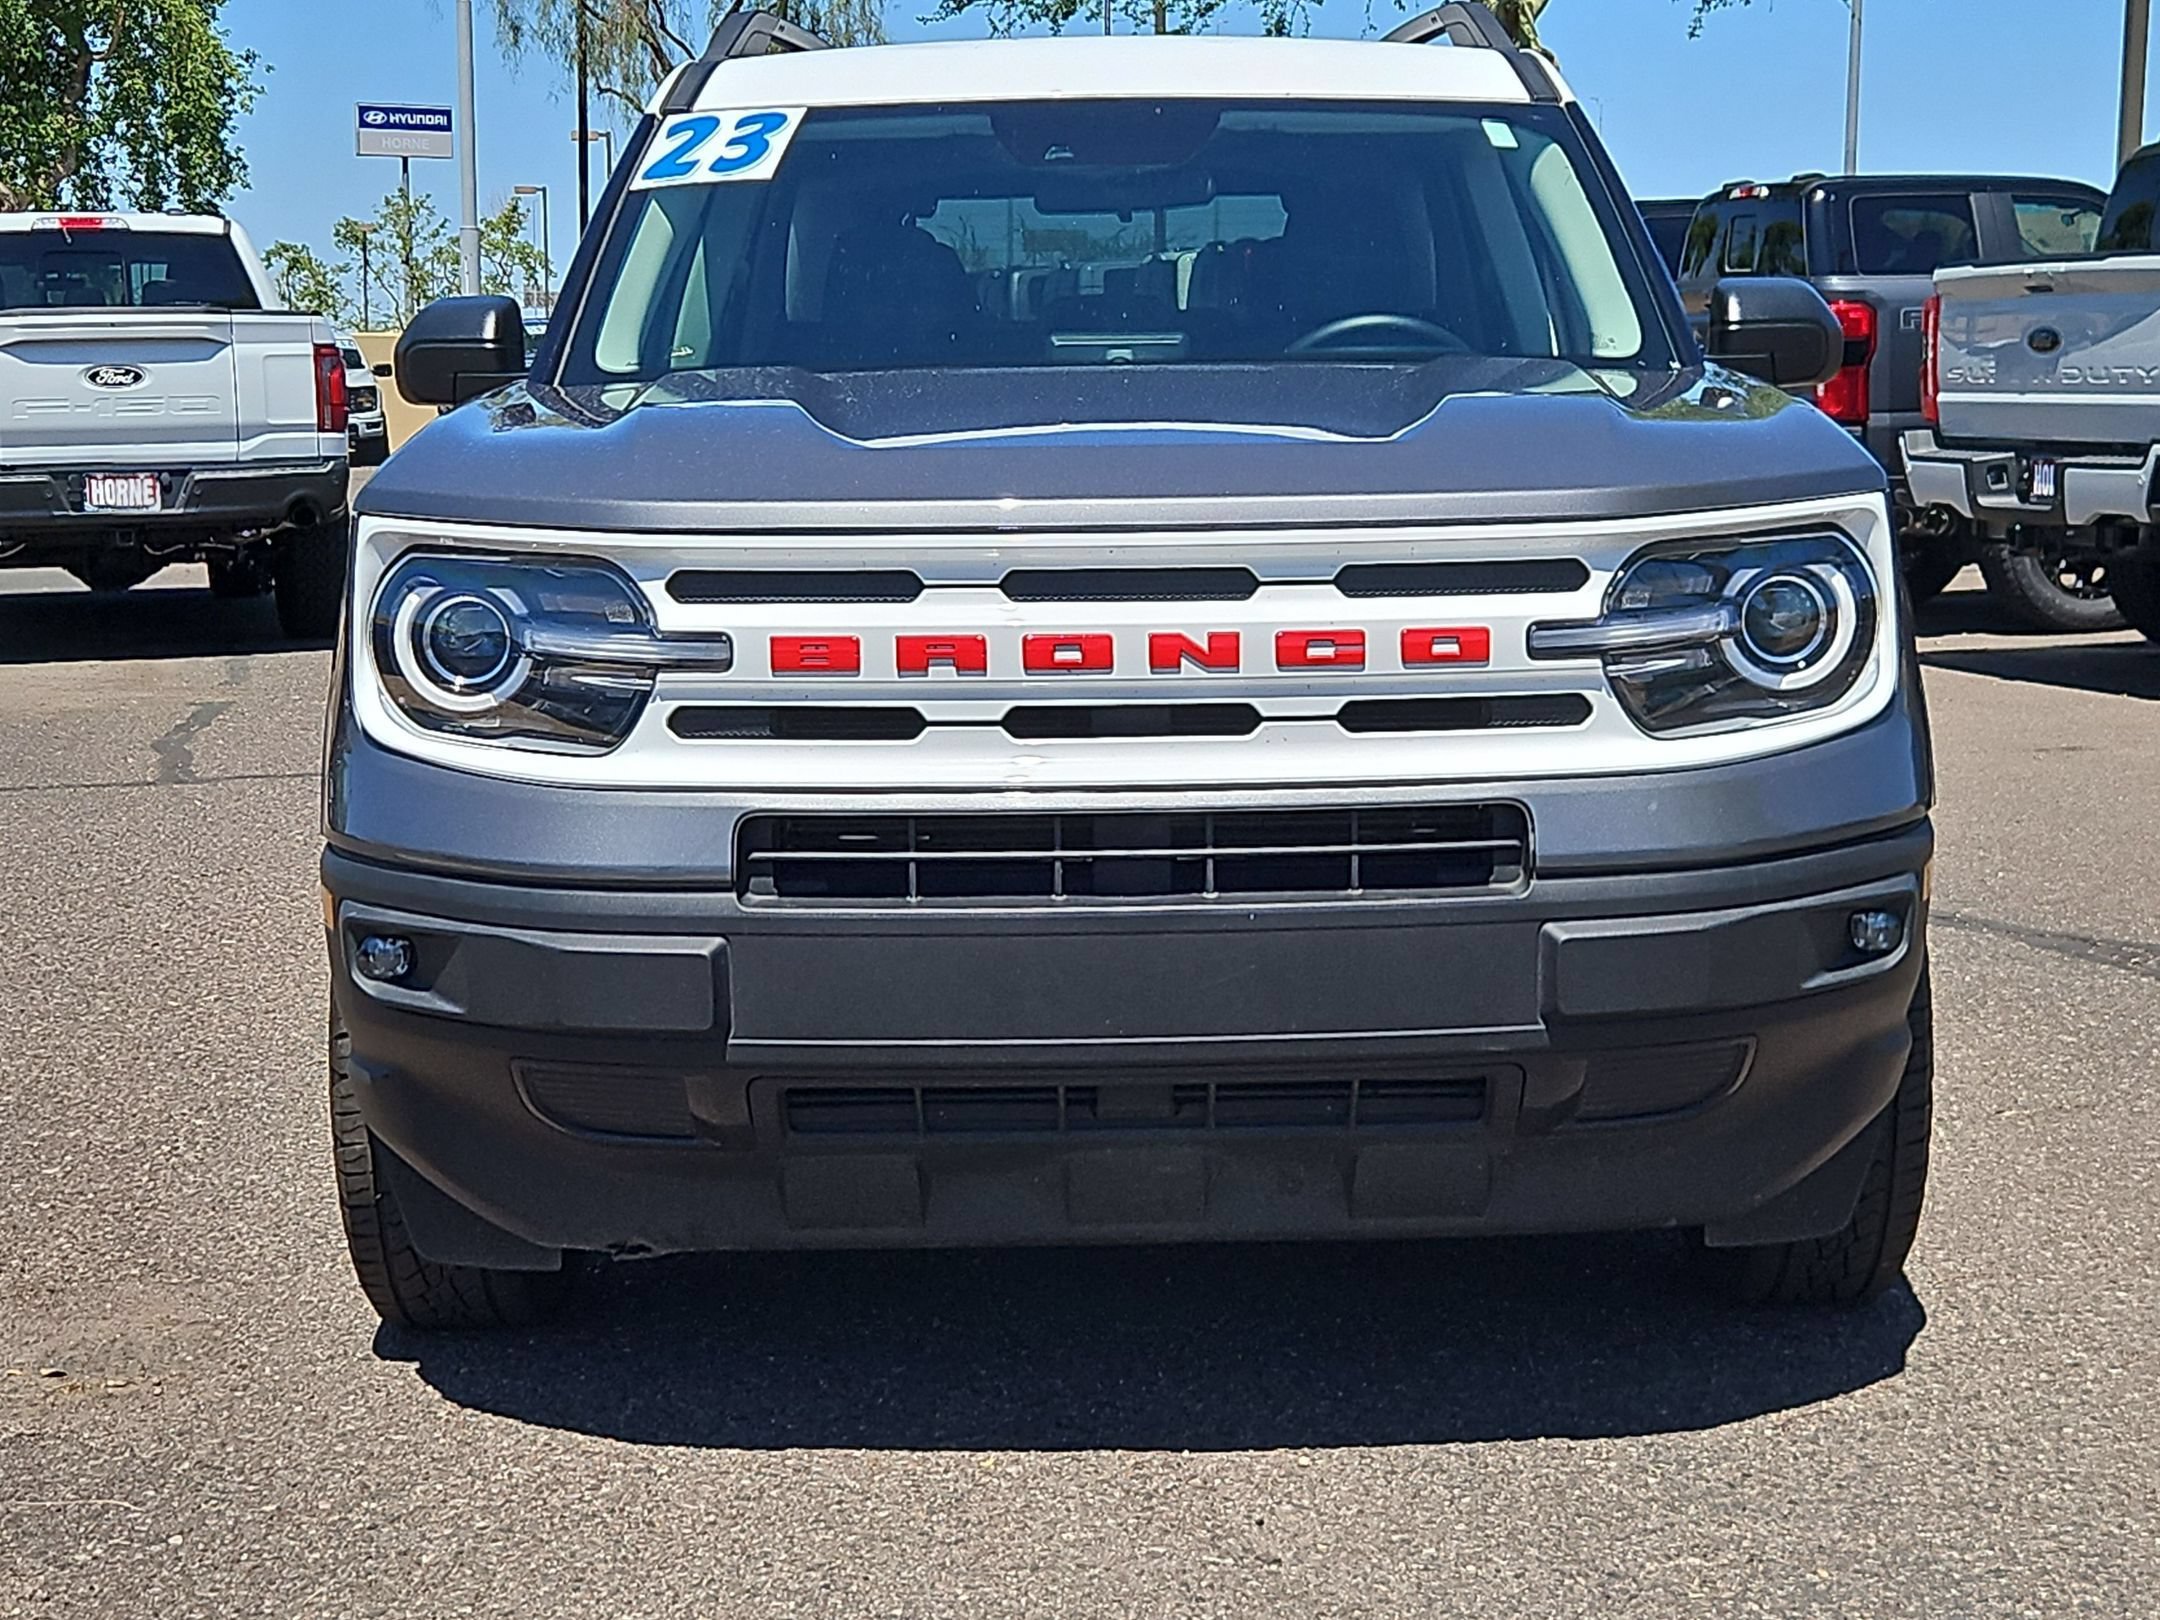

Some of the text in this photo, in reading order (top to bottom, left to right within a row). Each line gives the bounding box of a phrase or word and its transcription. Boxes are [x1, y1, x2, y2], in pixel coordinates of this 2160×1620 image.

[389, 112, 448, 126] HYUNDAI
[381, 136, 431, 151] HORNE
[641, 111, 789, 181] 23
[95, 366, 135, 386] Ford
[2061, 365, 2159, 385] DUTY
[11, 394, 222, 420] F-150
[90, 477, 156, 507] HORNE
[768, 626, 1492, 679] BRONCO
